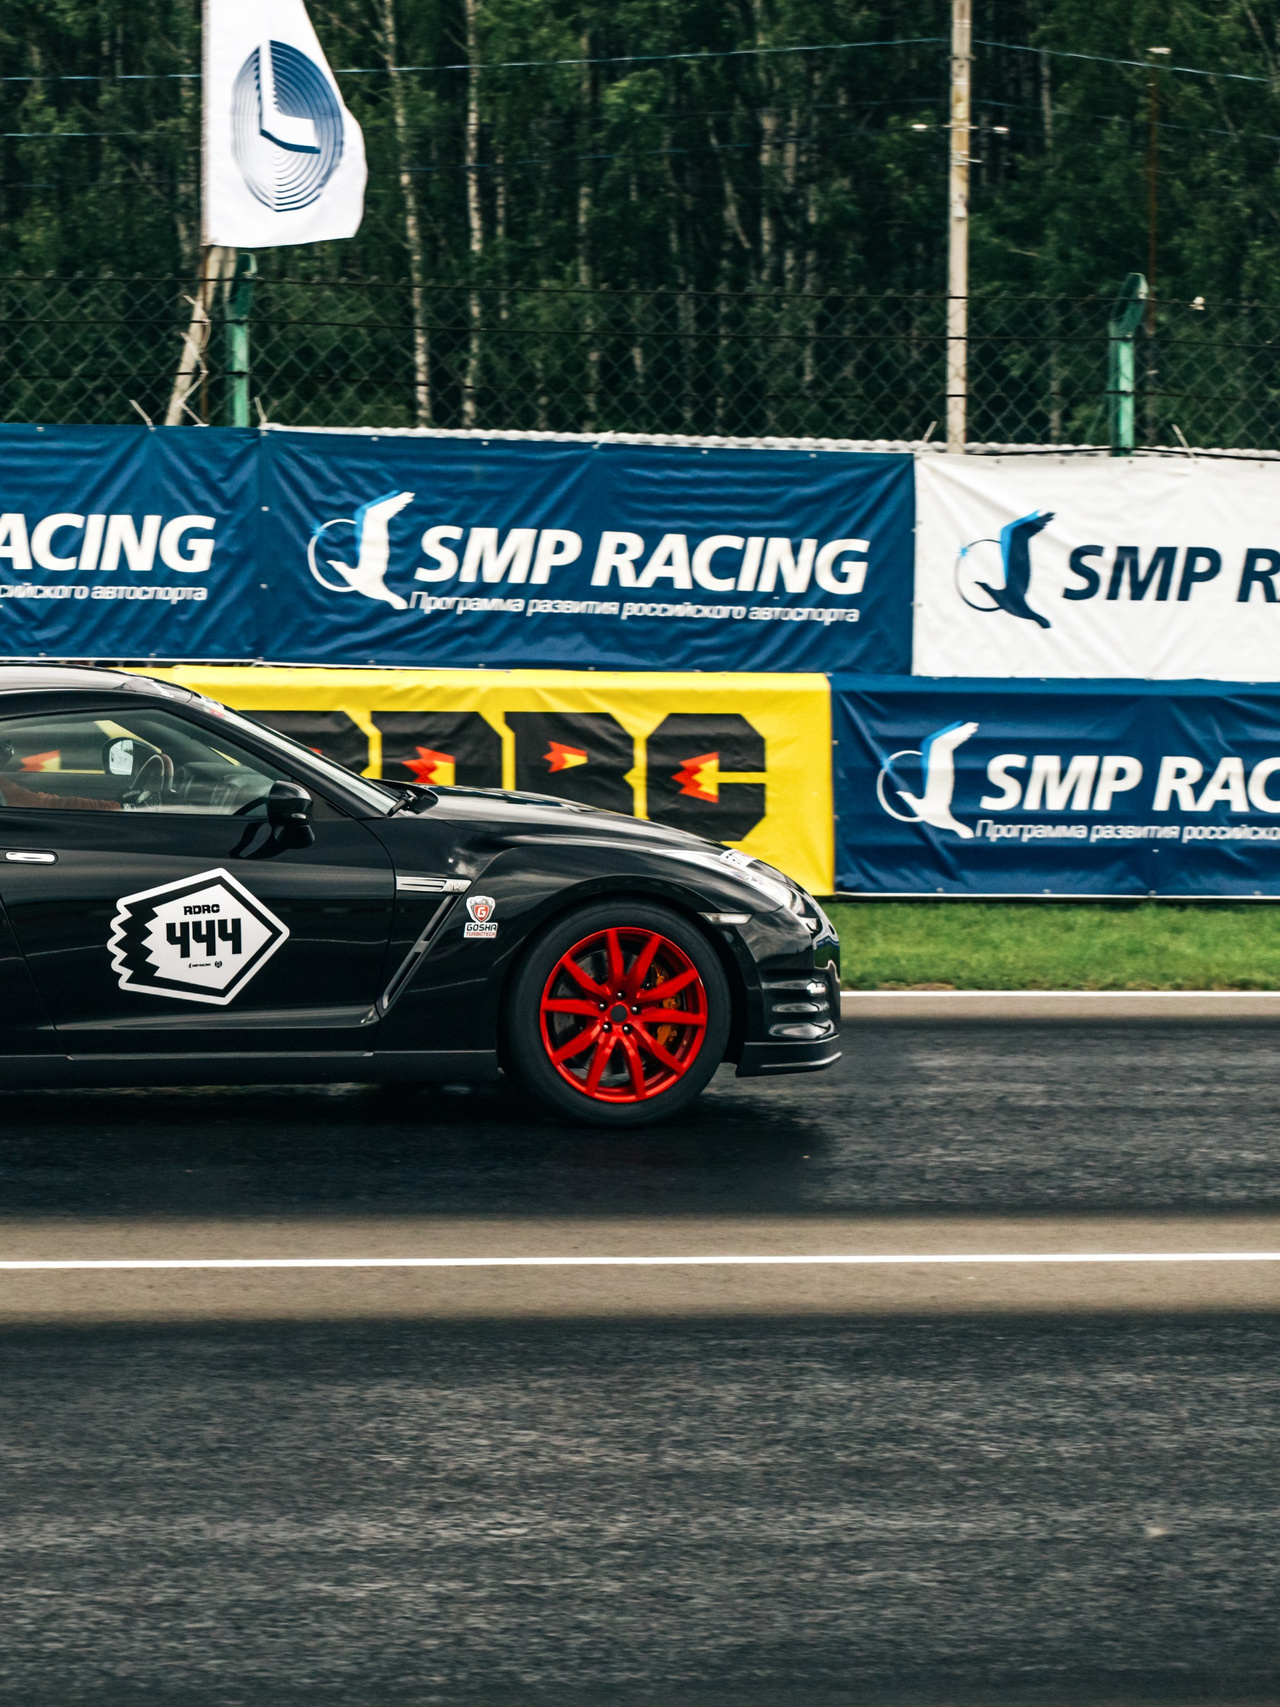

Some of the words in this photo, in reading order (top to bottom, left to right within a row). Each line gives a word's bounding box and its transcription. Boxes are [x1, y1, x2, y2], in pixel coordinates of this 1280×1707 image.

[414, 525, 583, 585] SMP
[590, 530, 870, 595] RACING
[1062, 544, 1222, 601] SMP
[91, 586, 207, 604] автоспорта
[409, 592, 525, 614] Программа
[527, 600, 620, 616] развития
[621, 602, 746, 619] российского
[749, 607, 859, 625] автоспорта
[979, 753, 1143, 811] SMP
[976, 820, 1087, 842] Программа
[1090, 825, 1180, 842] развития
[183, 903, 221, 916] RDRC
[166, 917, 242, 959] 444
[466, 923, 497, 932] GOSHA
